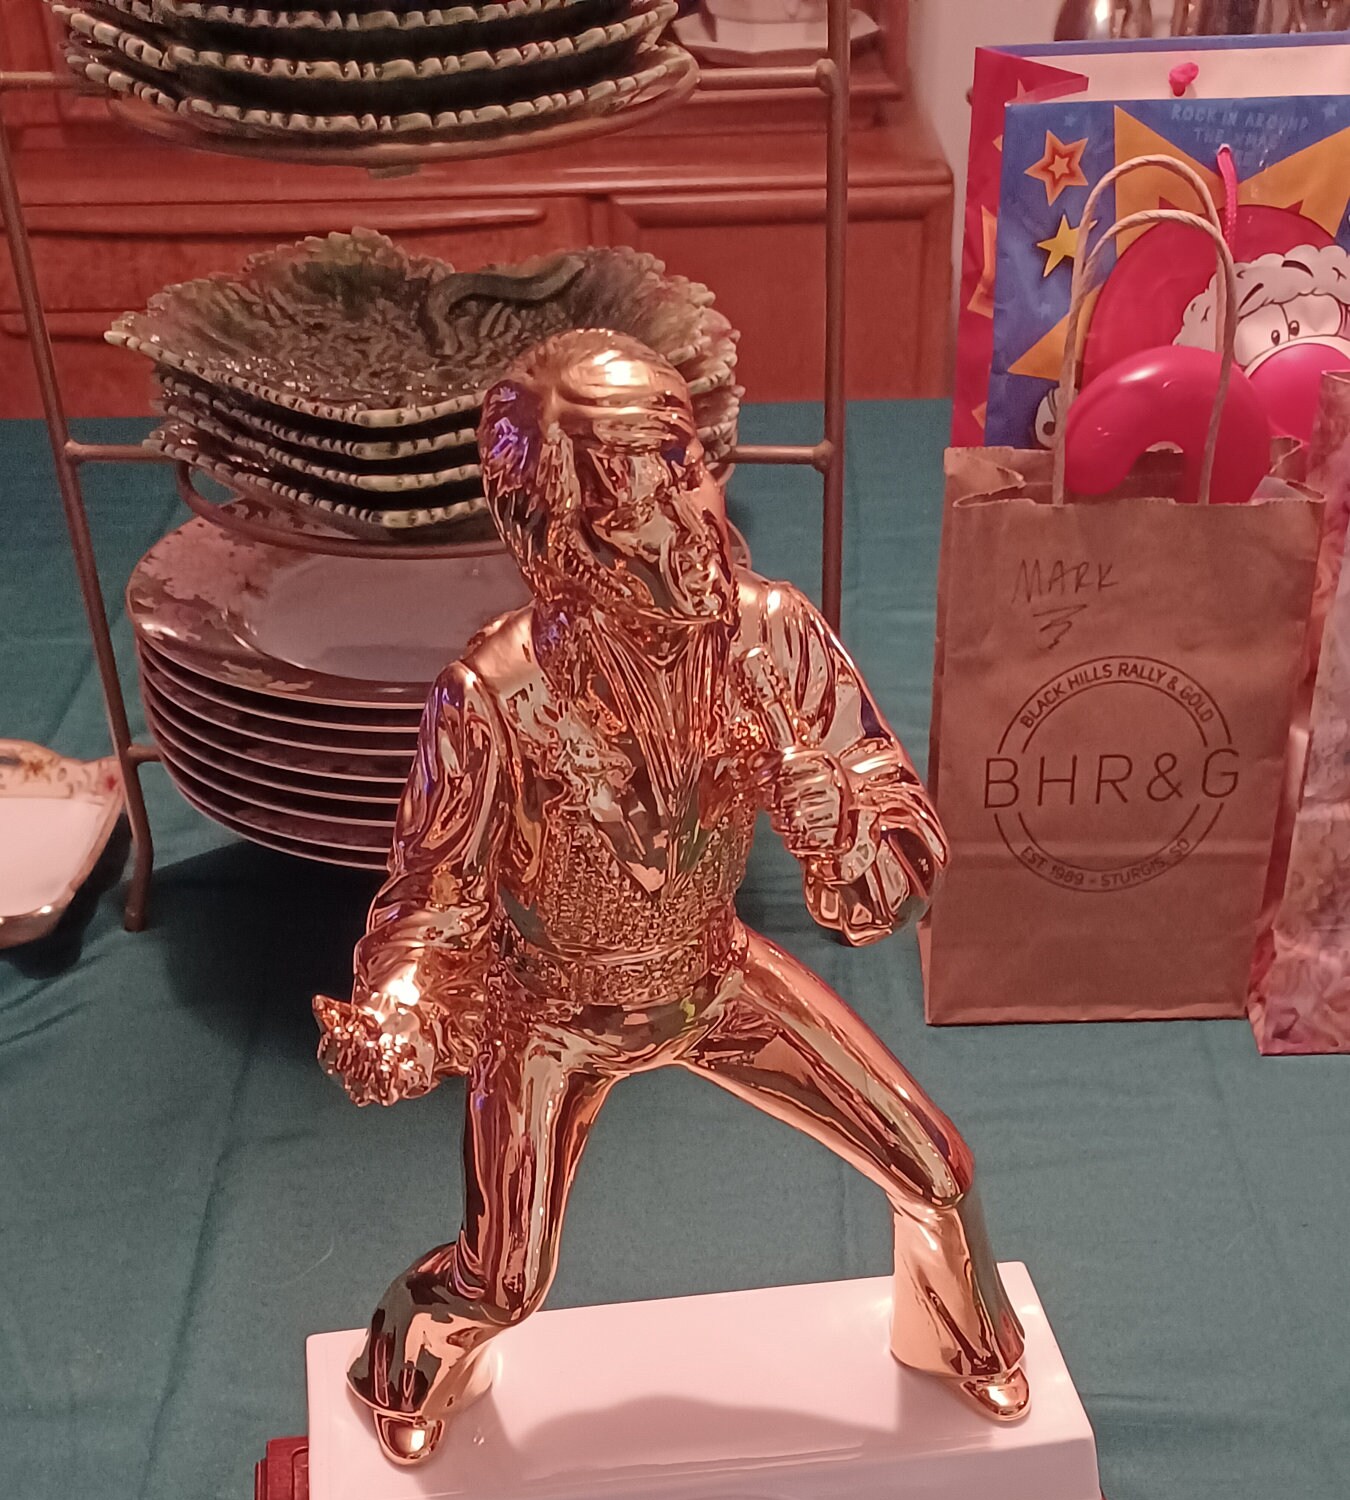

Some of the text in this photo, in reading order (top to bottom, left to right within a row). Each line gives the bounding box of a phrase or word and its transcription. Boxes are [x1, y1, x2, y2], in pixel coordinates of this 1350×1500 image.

[1193, 127, 1225, 143] THE
[1011, 559, 1119, 603] MARK
[1020, 662, 1214, 729] BLACK HILLS RALLY & GOLD
[1050, 864, 1084, 885] 1989
[1169, 837, 1191, 857] SD
